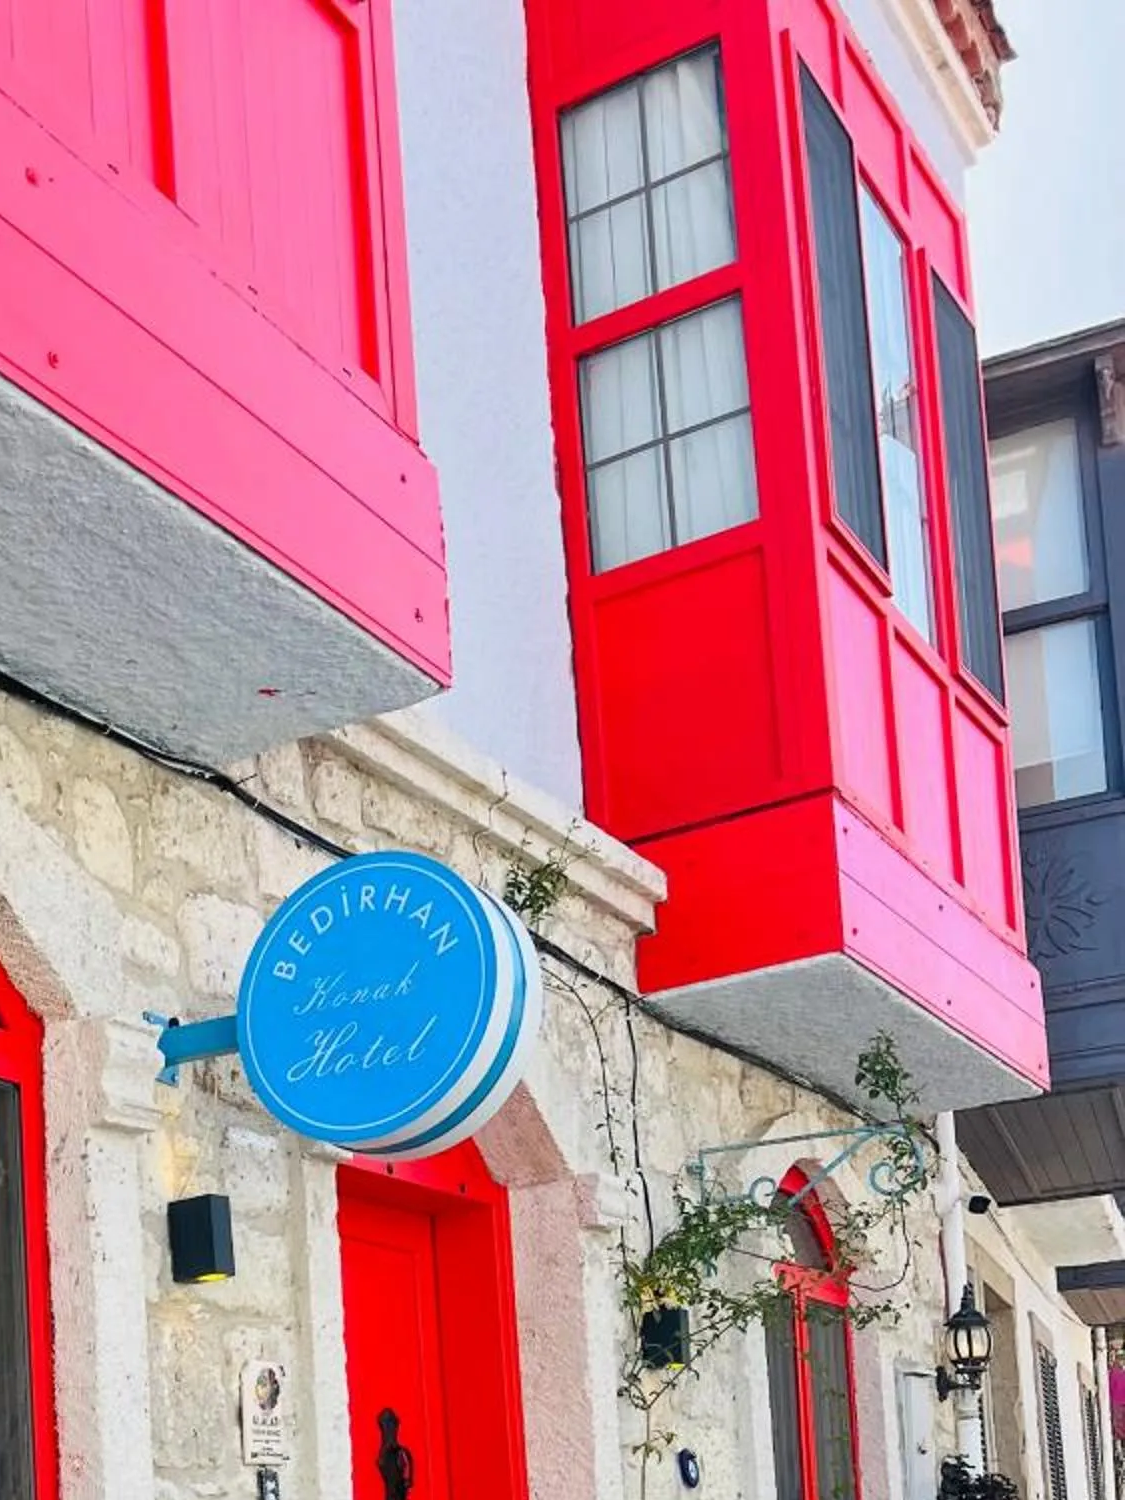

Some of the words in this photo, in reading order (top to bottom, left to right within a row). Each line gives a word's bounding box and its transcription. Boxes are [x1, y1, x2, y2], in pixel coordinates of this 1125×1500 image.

[273, 884, 459, 981] BEDİRHAN
[293, 961, 419, 1014] Konak
[286, 1015, 437, 1083] Hotel
